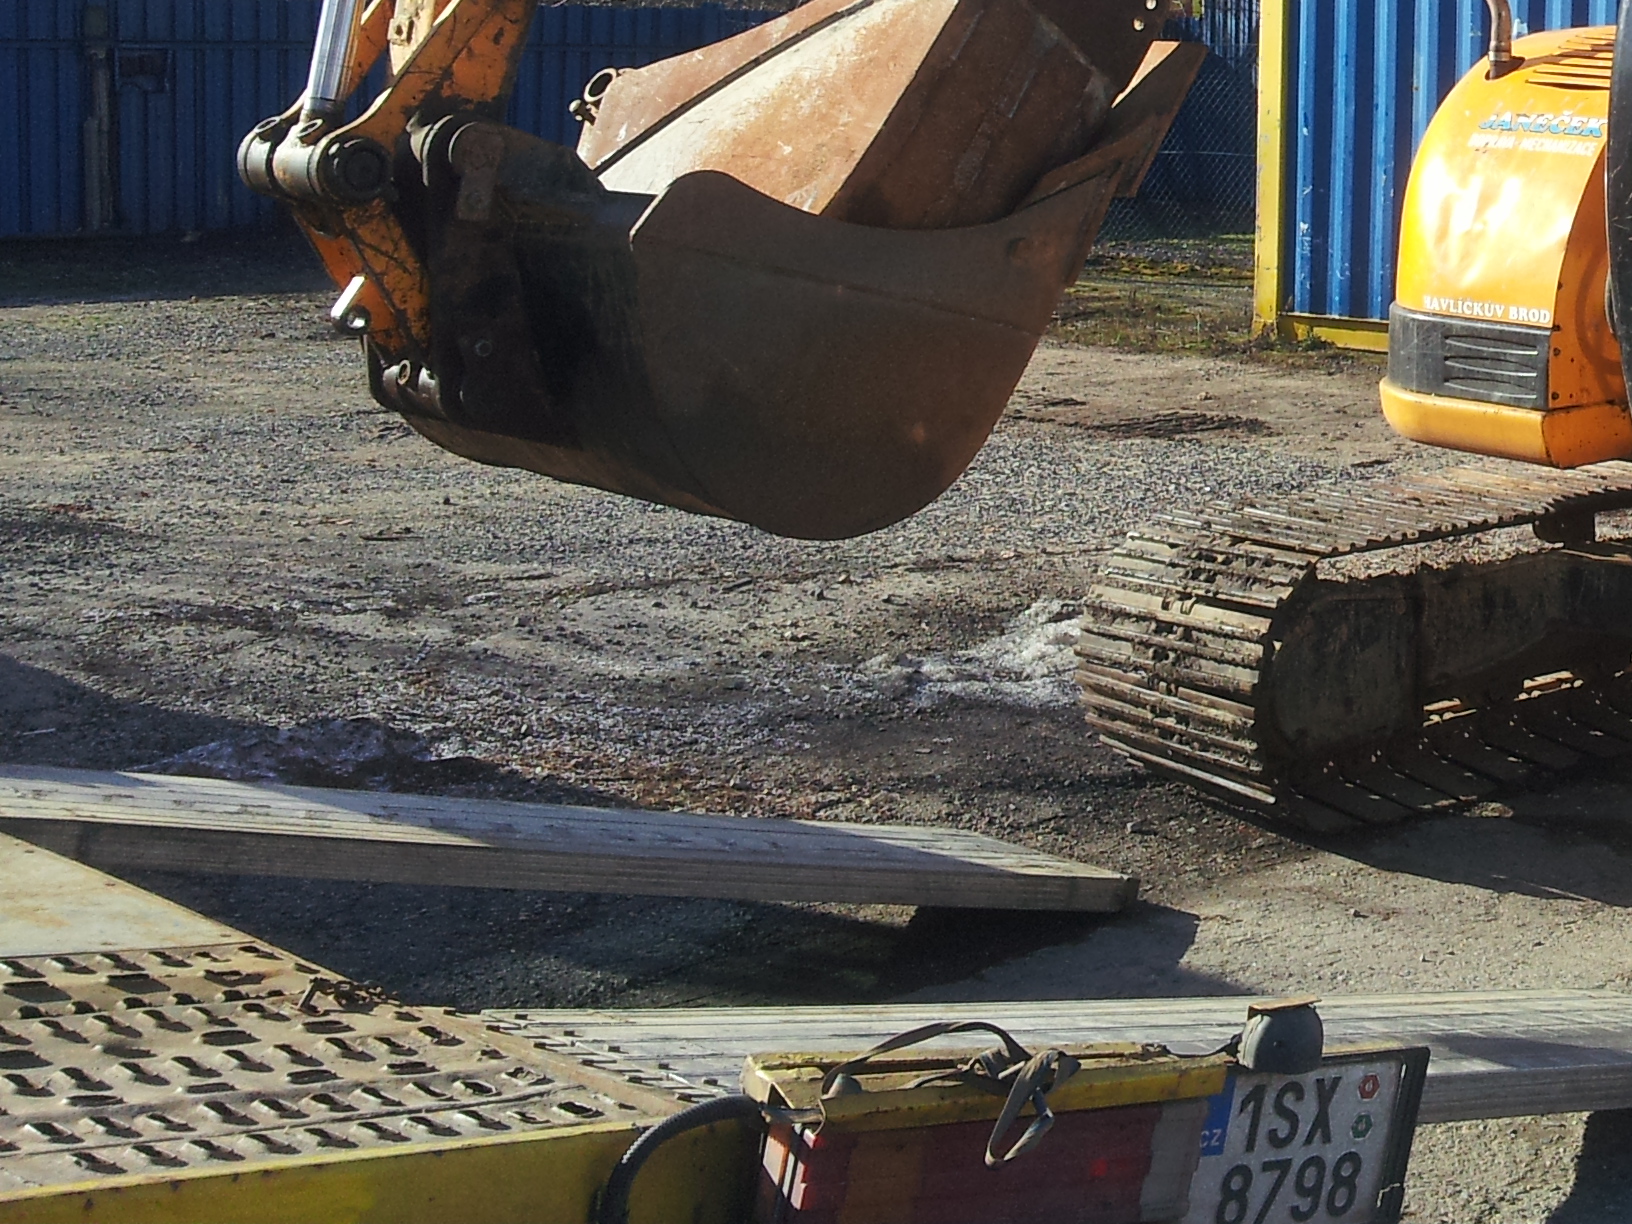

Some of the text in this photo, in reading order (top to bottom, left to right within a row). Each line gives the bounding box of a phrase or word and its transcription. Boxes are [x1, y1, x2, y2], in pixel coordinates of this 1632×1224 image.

[1478, 109, 1609, 138] JANEČEK
[1508, 306, 1551, 324] BROD
[1238, 1075, 1343, 1154] 1SX
[1200, 1128, 1221, 1149] CZ
[1215, 1150, 1363, 1224] 8798
